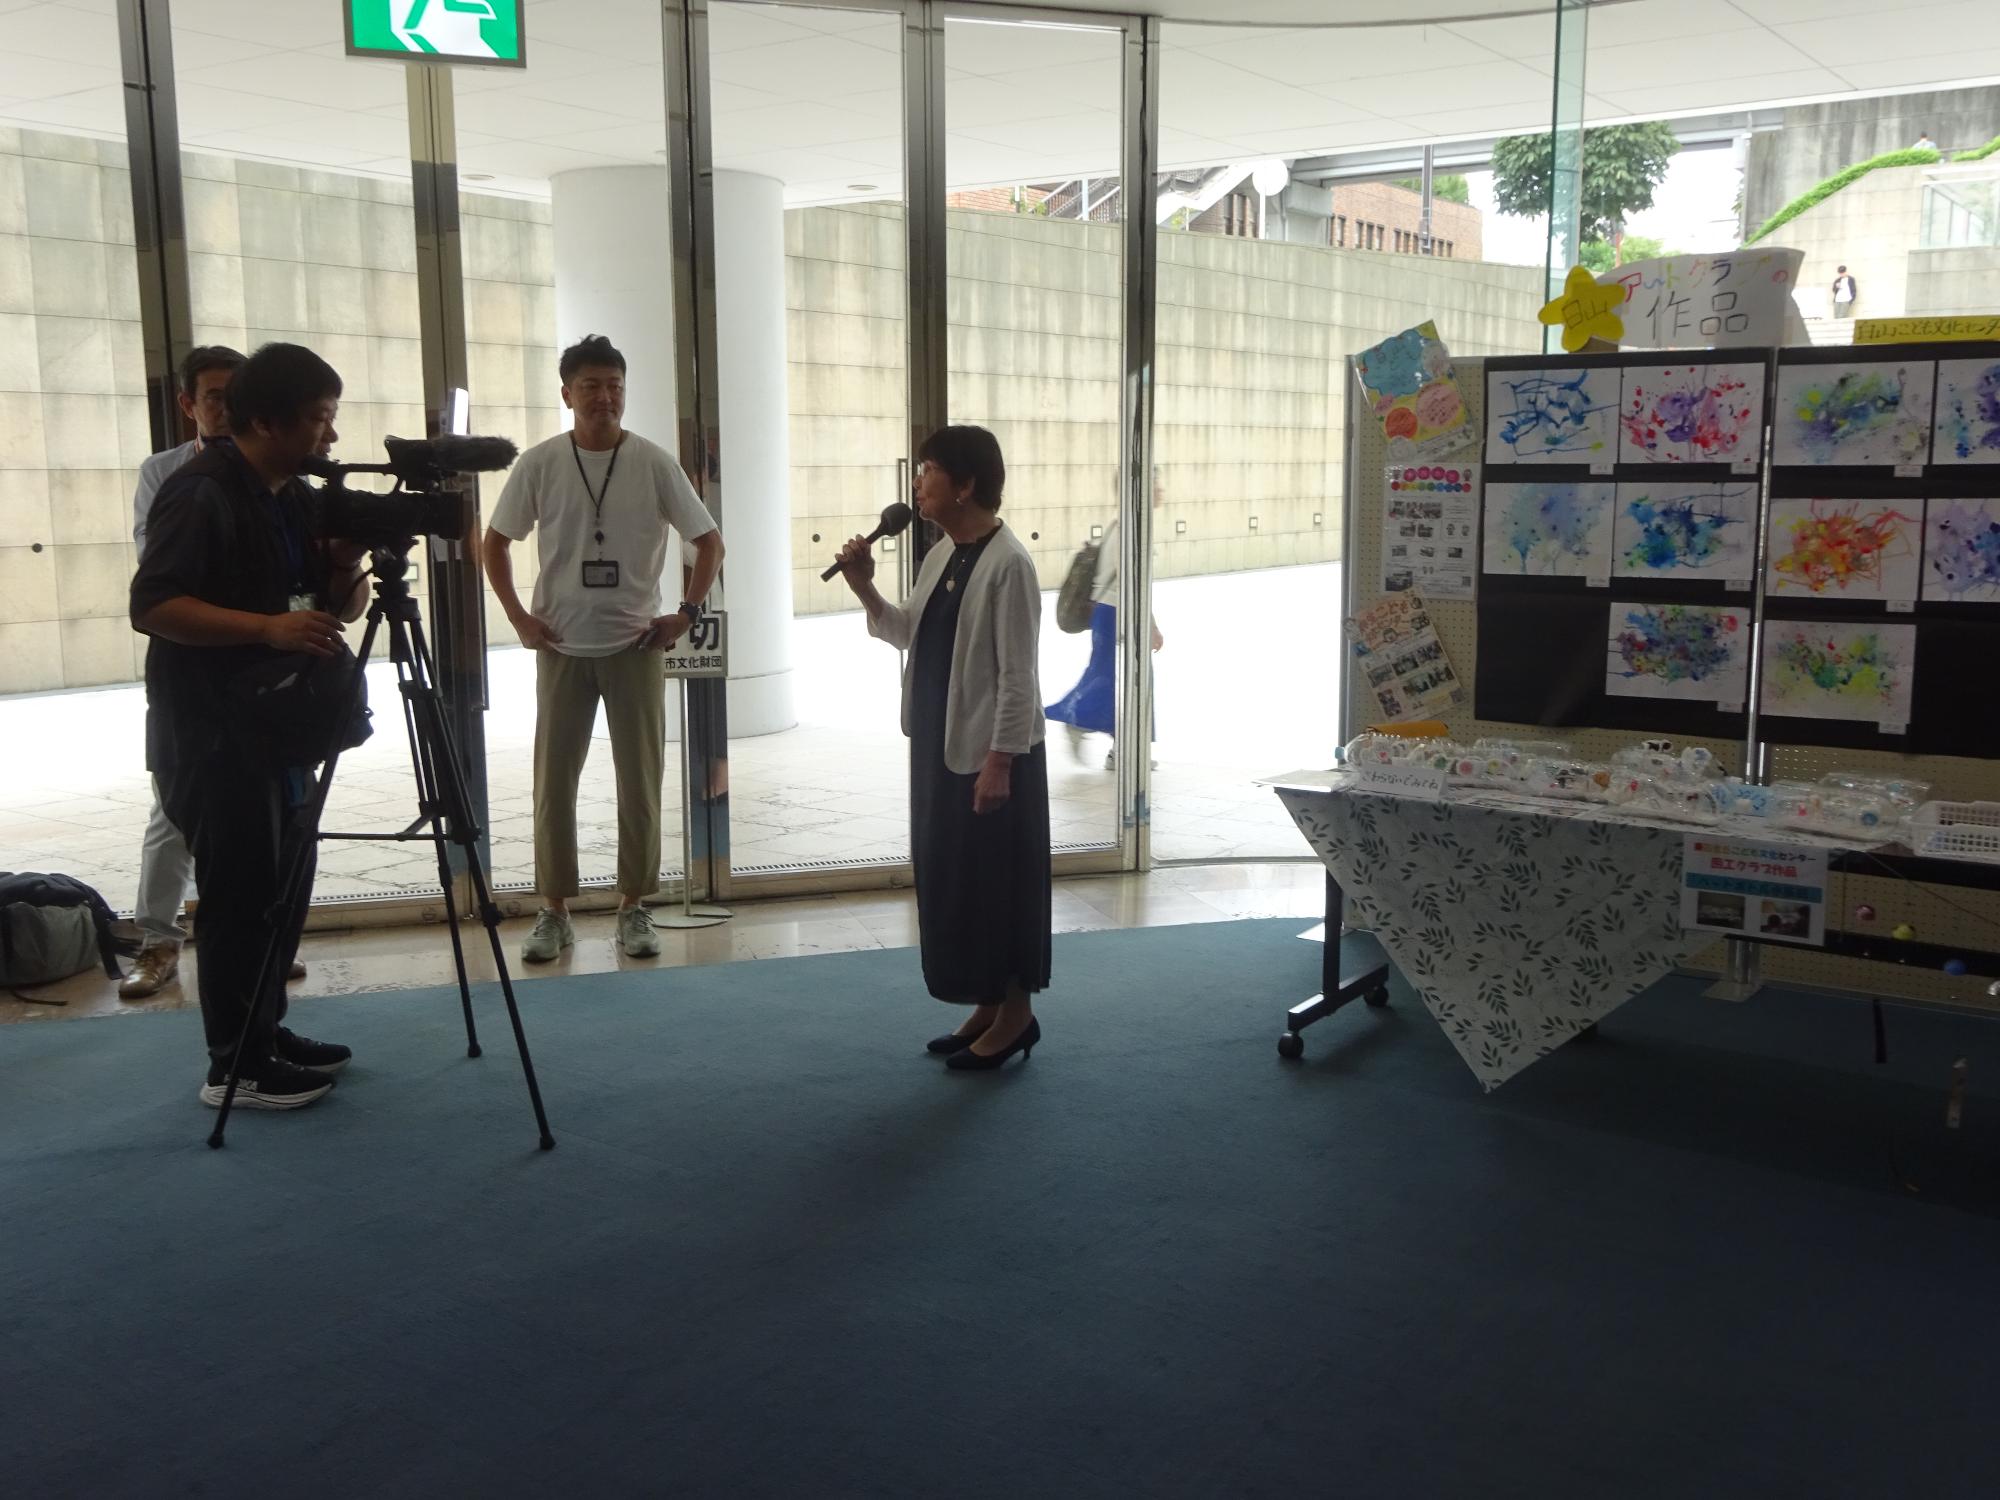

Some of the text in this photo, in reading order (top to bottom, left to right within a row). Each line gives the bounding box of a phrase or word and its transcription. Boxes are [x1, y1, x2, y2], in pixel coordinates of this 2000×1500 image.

[1646, 290, 1749, 340] 作品
[664, 655, 721, 669] 市文化財団
